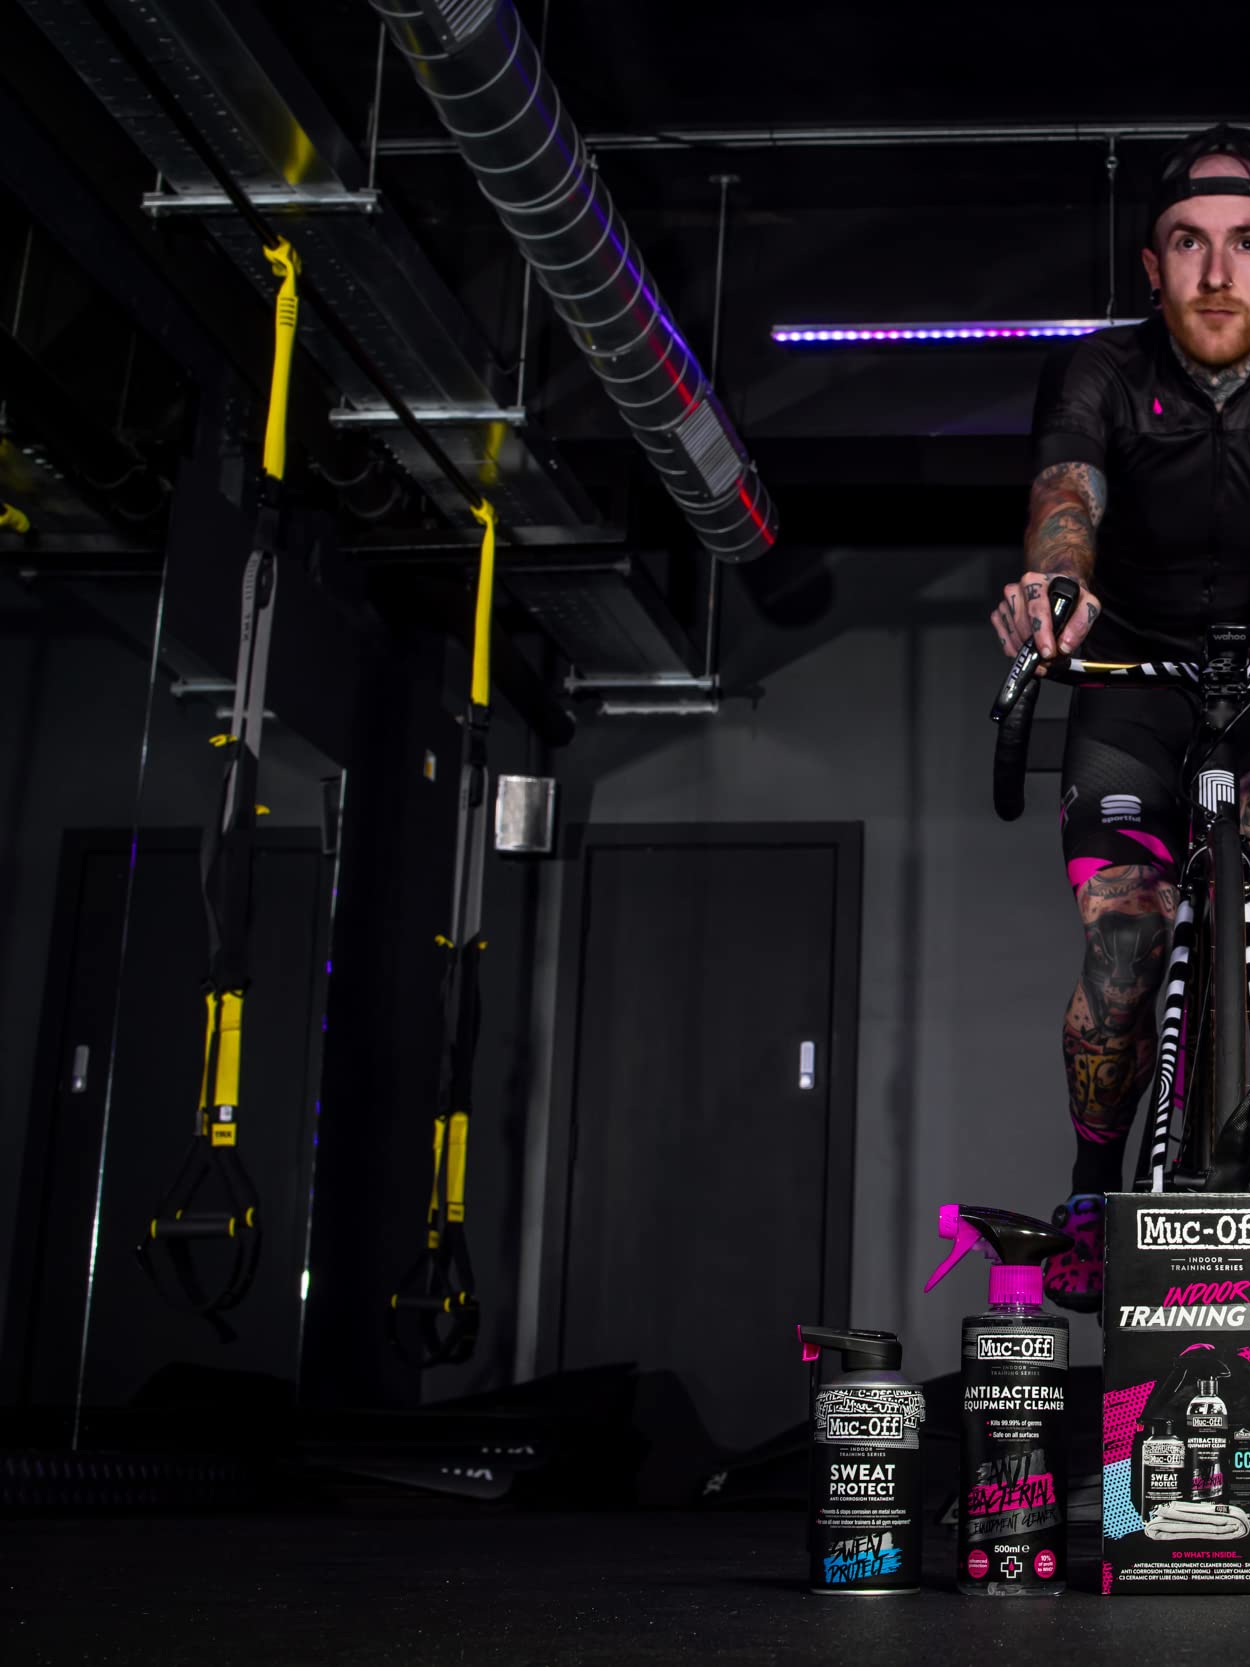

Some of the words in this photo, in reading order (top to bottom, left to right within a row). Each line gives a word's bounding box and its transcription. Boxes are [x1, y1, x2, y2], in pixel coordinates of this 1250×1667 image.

[1213, 632, 1246, 640] wahoo
[1163, 1280, 1250, 1308] INDOOR
[1119, 1306, 1246, 1326] TRAINING
[981, 1338, 1051, 1356] Muc-Off
[964, 1386, 1064, 1399] ANTIBACTERIAL
[964, 1400, 1021, 1412] EQUIPMENT
[1024, 1400, 1064, 1410] CLEANER
[830, 1417, 900, 1436] Muc-Off
[830, 1464, 895, 1480] SWEAT
[830, 1482, 895, 1495] PROTECT
